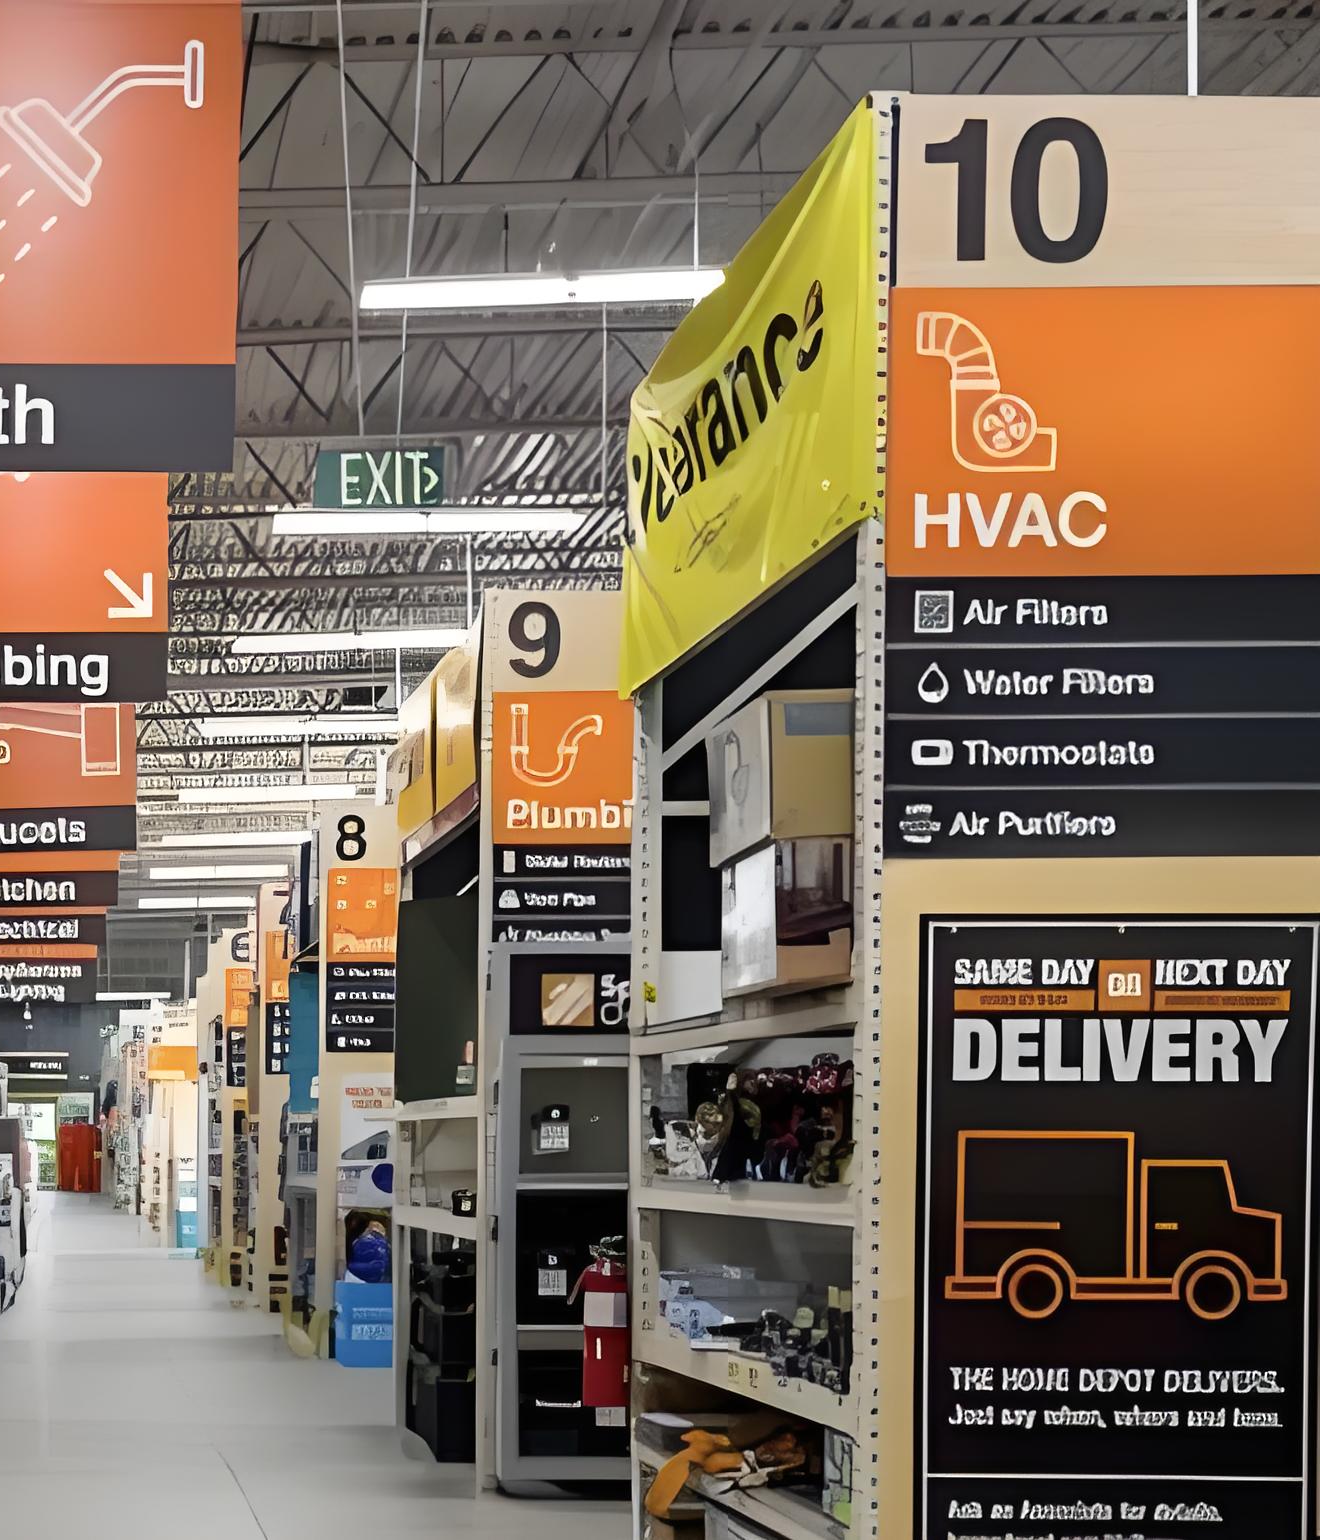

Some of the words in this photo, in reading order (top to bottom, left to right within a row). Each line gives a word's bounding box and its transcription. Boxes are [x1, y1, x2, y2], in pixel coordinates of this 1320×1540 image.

[925, 117, 1108, 263] 10
[340, 451, 429, 504] EXIT
[914, 491, 1107, 548] HVAC
[963, 599, 1008, 625] Air
[509, 602, 560, 678] 9
[336, 814, 366, 860] 8
[949, 812, 989, 836] Air
[954, 959, 1033, 985] SAME
[1041, 959, 1095, 985] DAY
[1155, 959, 1228, 985] NEXT
[1237, 959, 1291, 985] DAY
[952, 1019, 1289, 1082] DELIVERY
[949, 1367, 993, 1391] THE
[1002, 1368, 1068, 1391] HOME
[1080, 1369, 1155, 1392] DEPOT
